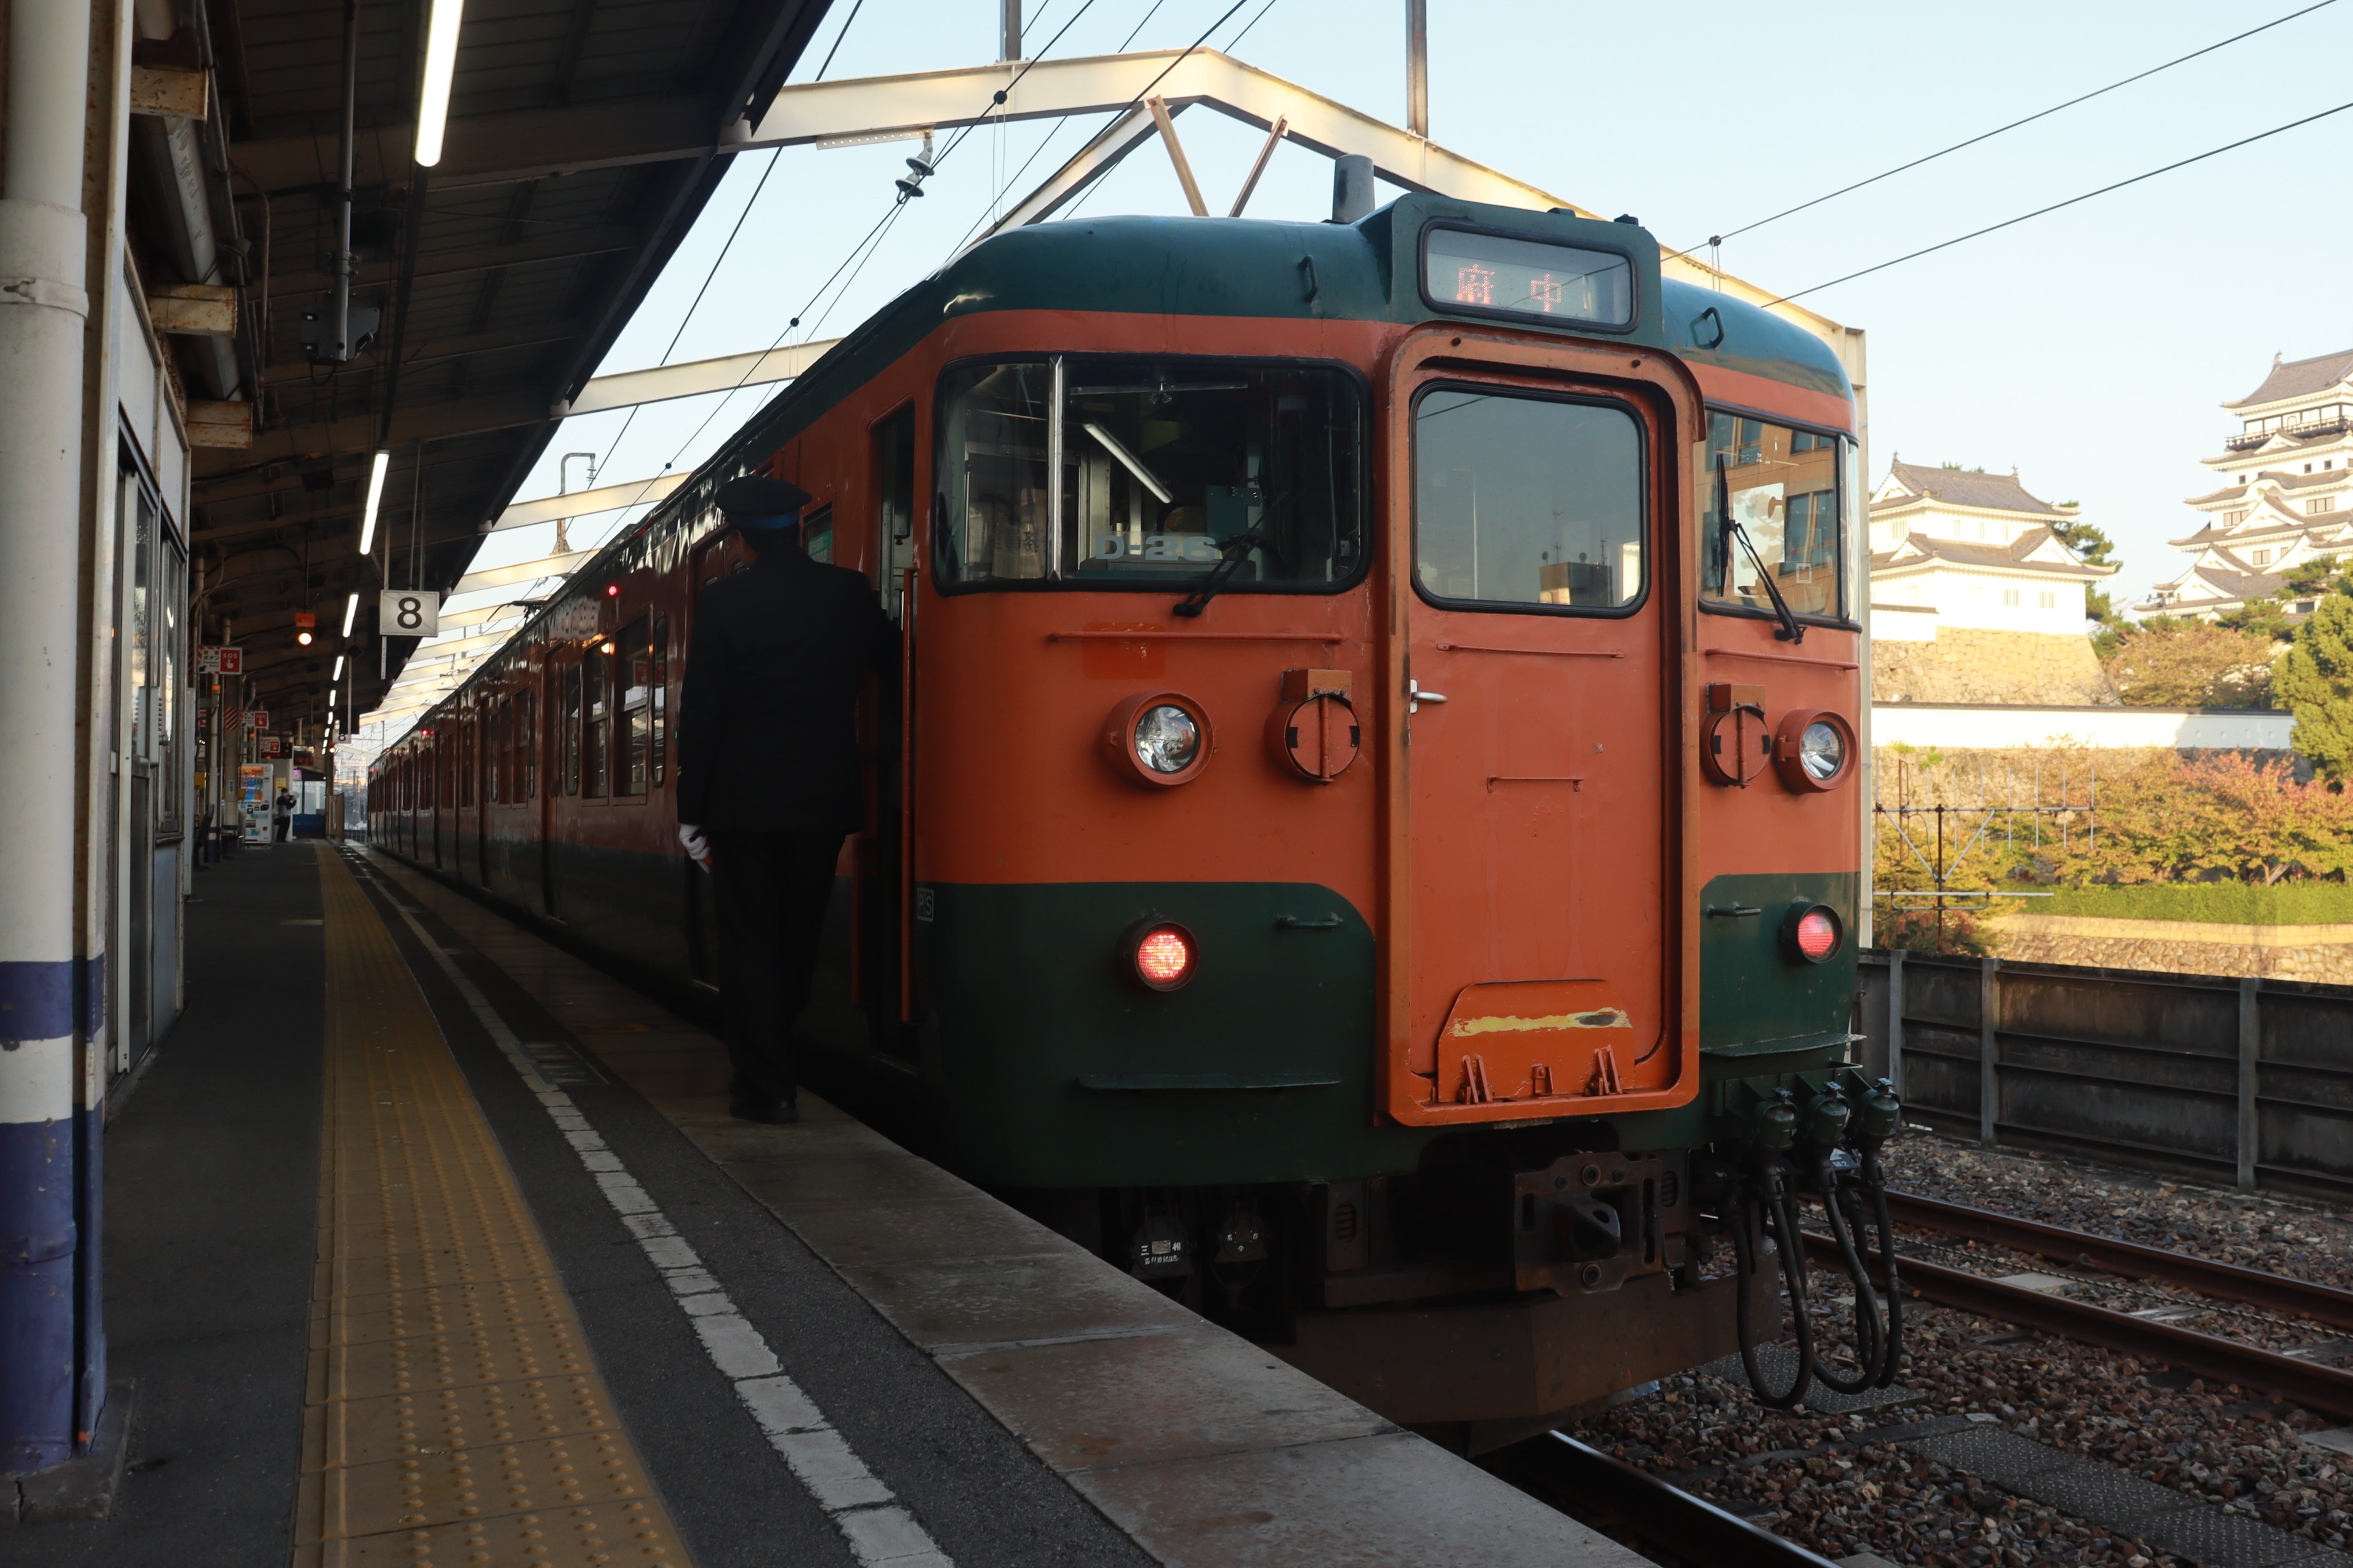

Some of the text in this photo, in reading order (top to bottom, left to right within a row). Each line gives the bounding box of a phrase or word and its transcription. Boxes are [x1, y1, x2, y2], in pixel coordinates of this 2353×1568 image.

[1456, 264, 1562, 312] 府中
[1095, 534, 1216, 562] D-26
[397, 597, 422, 629] 8
